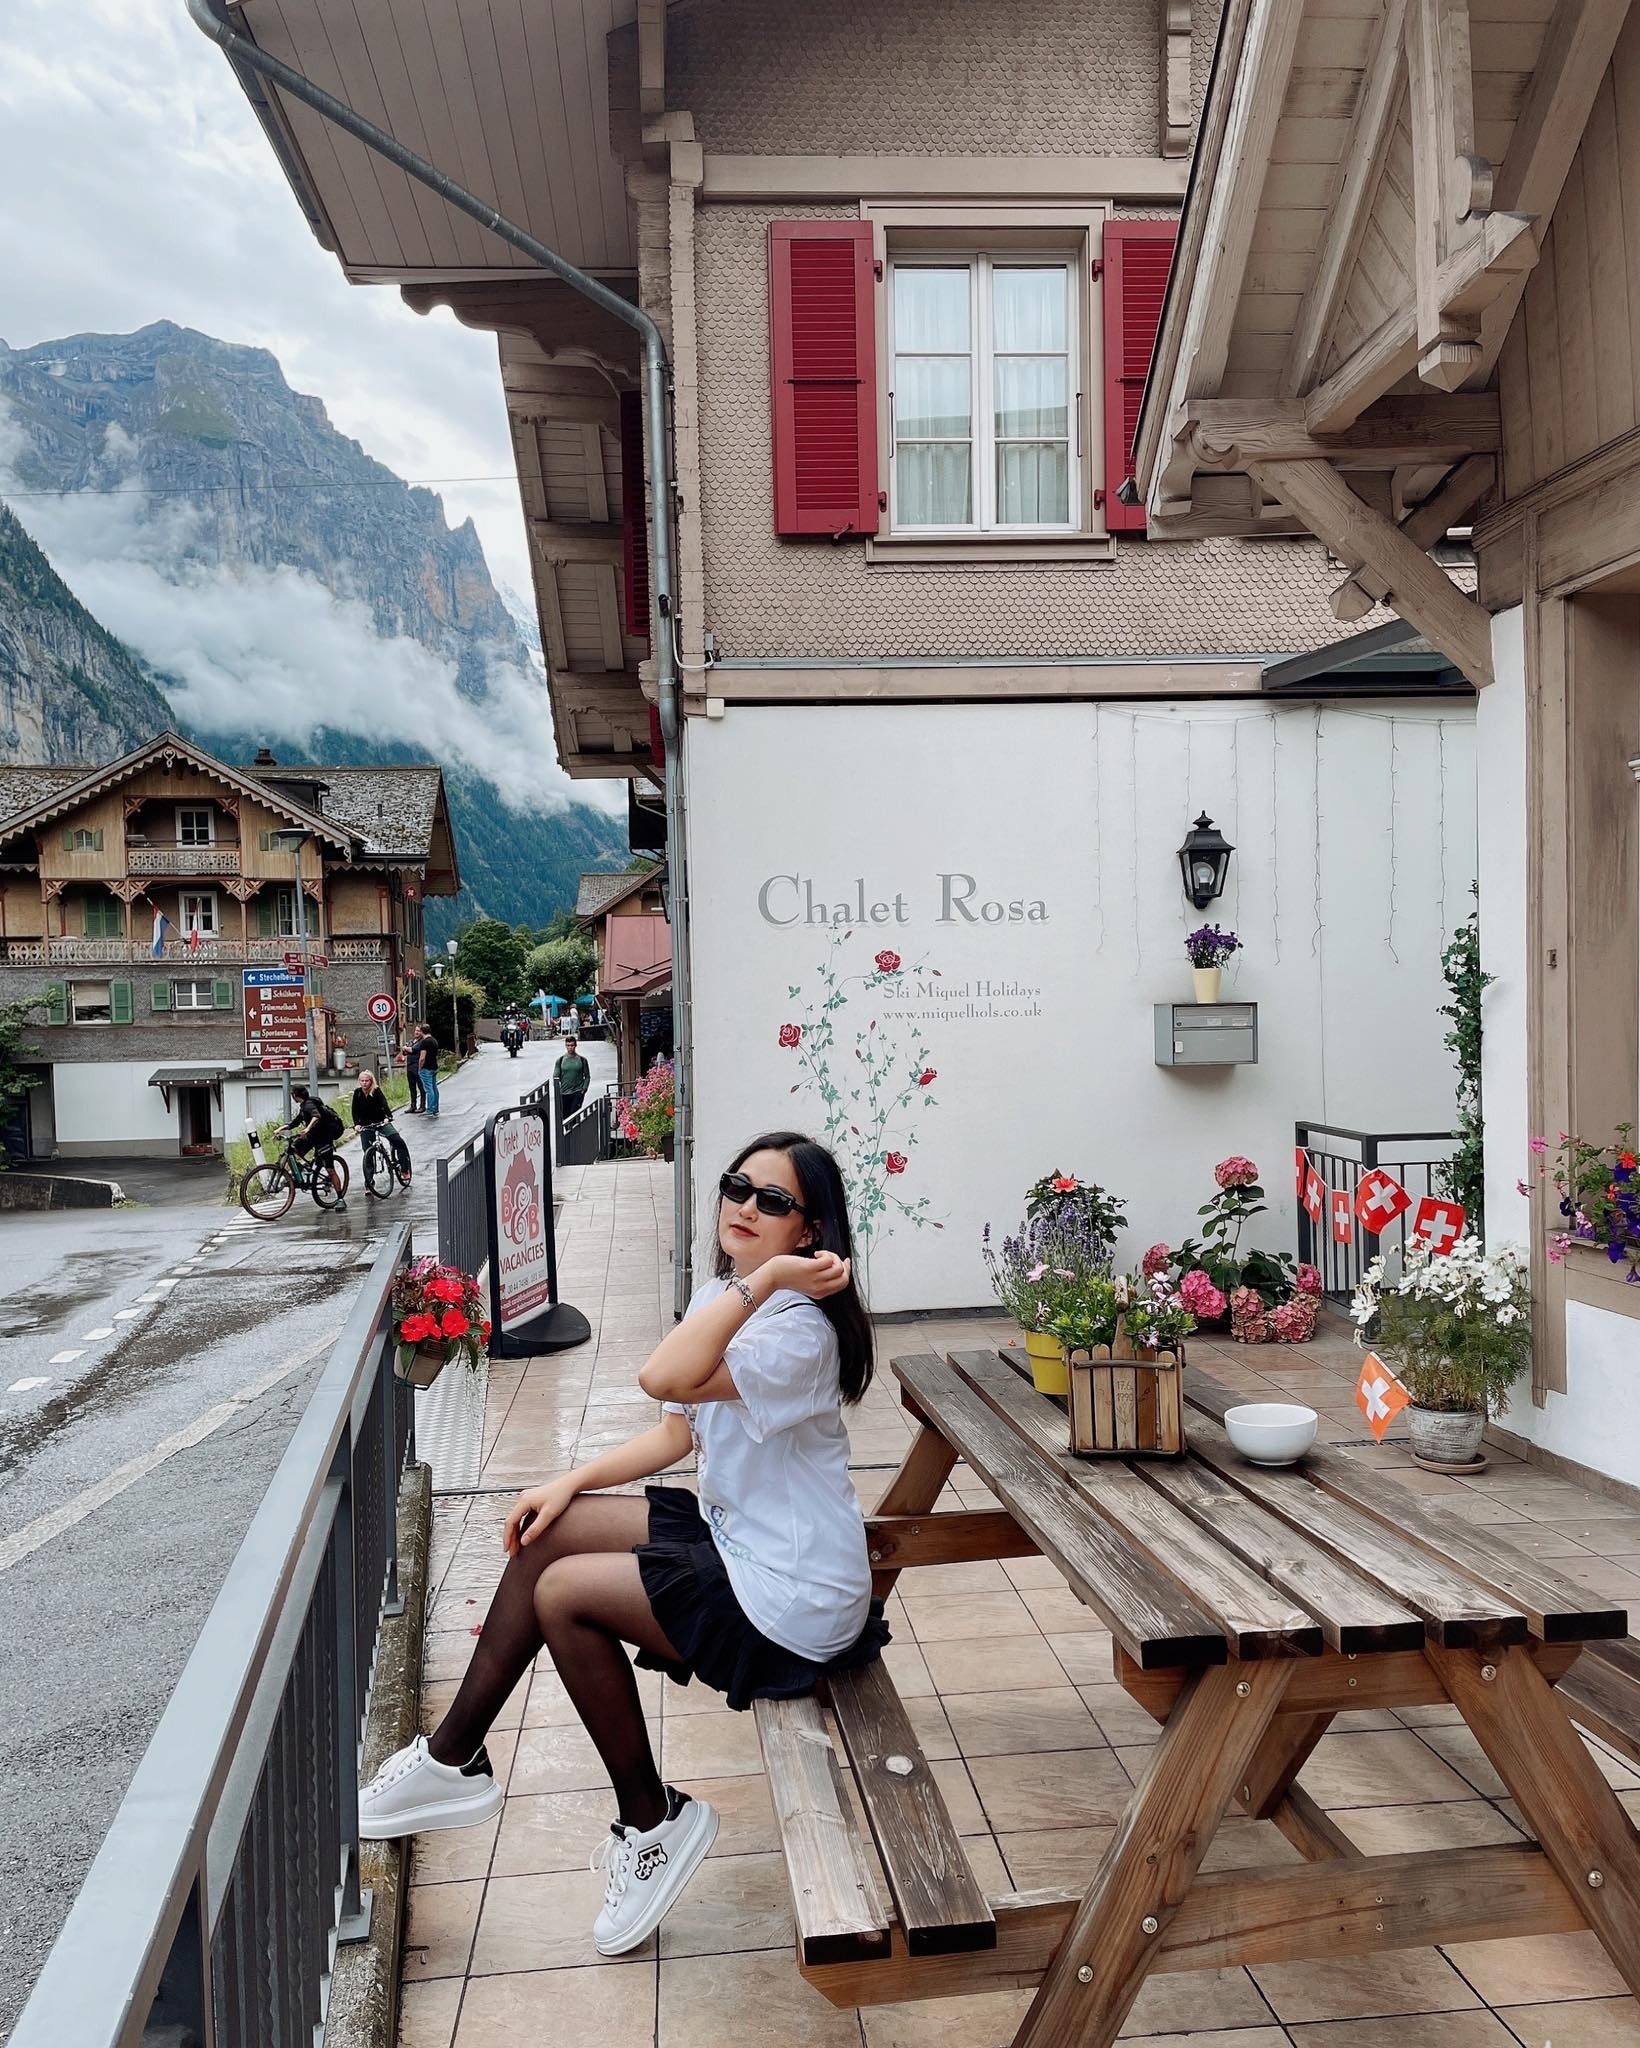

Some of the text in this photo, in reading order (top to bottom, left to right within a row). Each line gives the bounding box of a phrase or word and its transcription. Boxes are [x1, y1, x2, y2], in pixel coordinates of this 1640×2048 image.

[757, 872, 1050, 926] Chalet Rosa
[259, 972, 296, 982] Stechelberg
[882, 980, 1042, 1001] Ski Miquel Holidays
[375, 1002, 388, 1014] 30
[882, 1001, 1043, 1021] www.miquelhols.co.uk
[265, 1043, 290, 1053] Jungfrau
[497, 1122, 542, 1159] Chalet Rosa
[499, 1242, 545, 1275] VACANCIES
